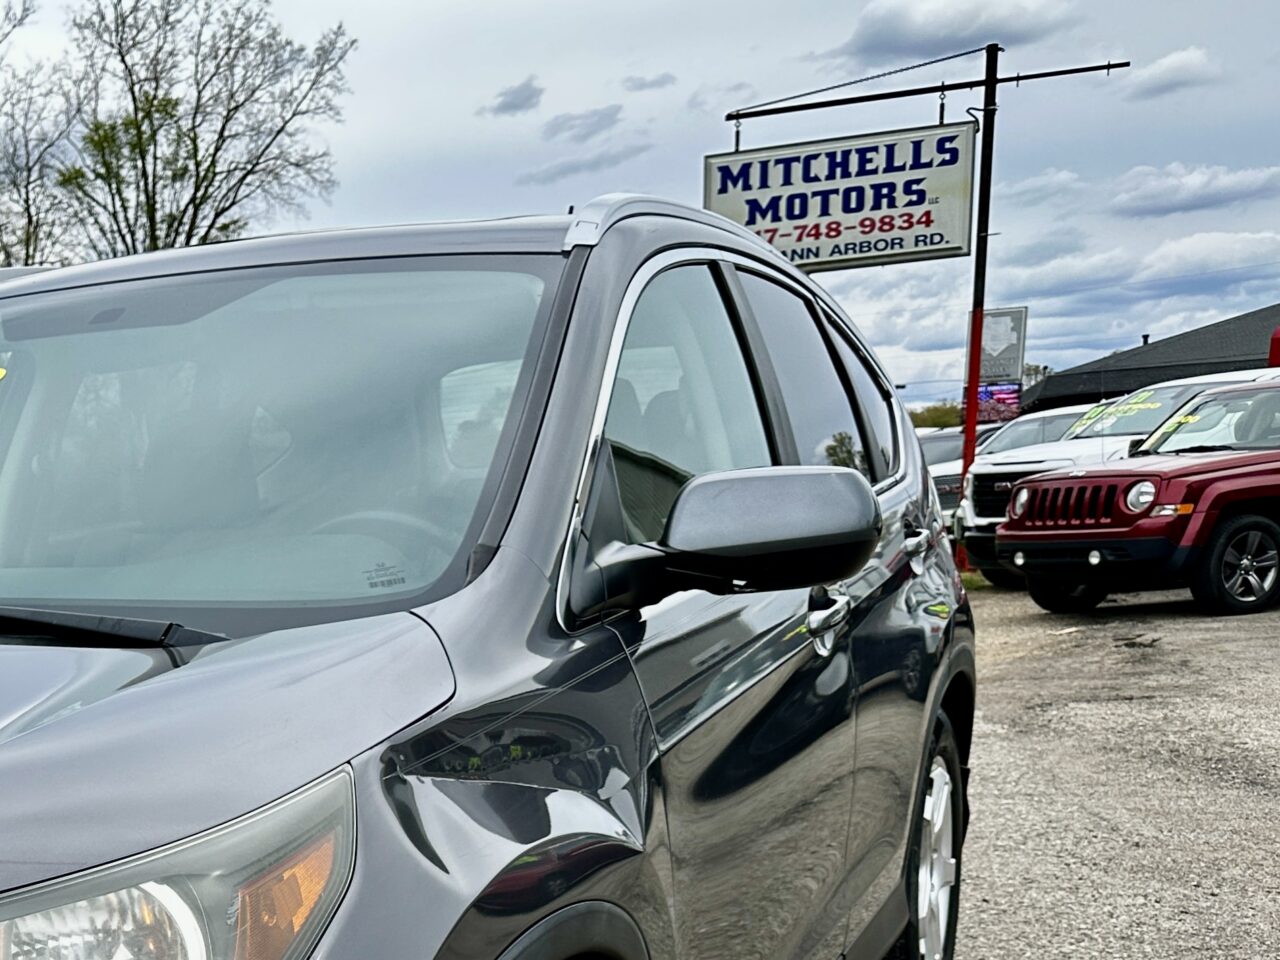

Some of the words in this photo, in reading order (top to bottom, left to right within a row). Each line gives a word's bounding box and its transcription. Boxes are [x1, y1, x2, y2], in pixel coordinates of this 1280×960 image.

[717, 135, 960, 195] MITCHELLS
[744, 177, 927, 226] MOTORS
[829, 237, 905, 258] ARBOR
[914, 232, 950, 248] RD.
